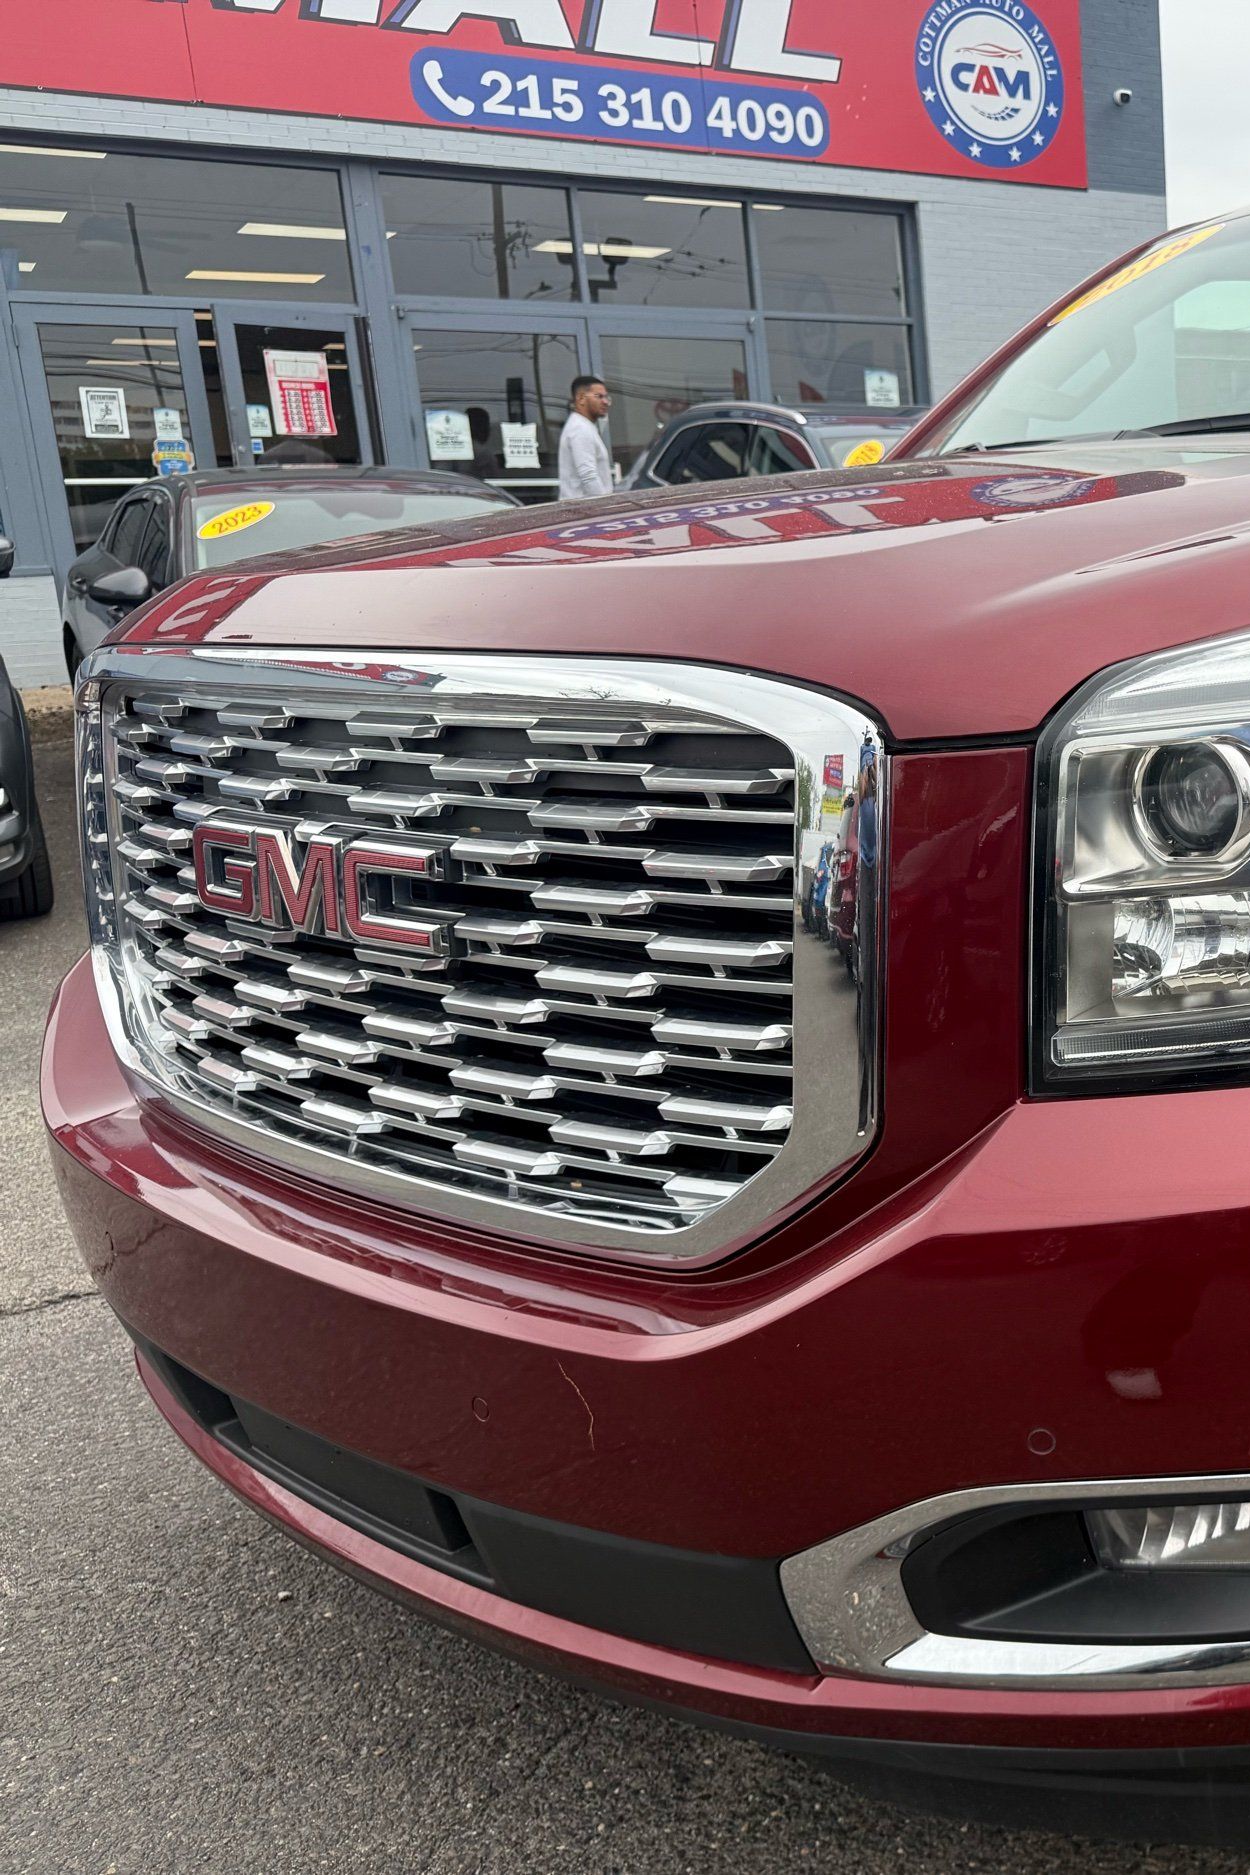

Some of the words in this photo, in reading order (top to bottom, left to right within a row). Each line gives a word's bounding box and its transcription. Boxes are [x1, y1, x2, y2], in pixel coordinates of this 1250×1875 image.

[1028, 24, 1058, 81] MALL
[479, 70, 584, 123] 215
[598, 84, 692, 134] 310
[706, 96, 824, 147] 4090
[950, 62, 1031, 101] CAM
[211, 506, 262, 534] 2023
[192, 818, 449, 957] GMC
